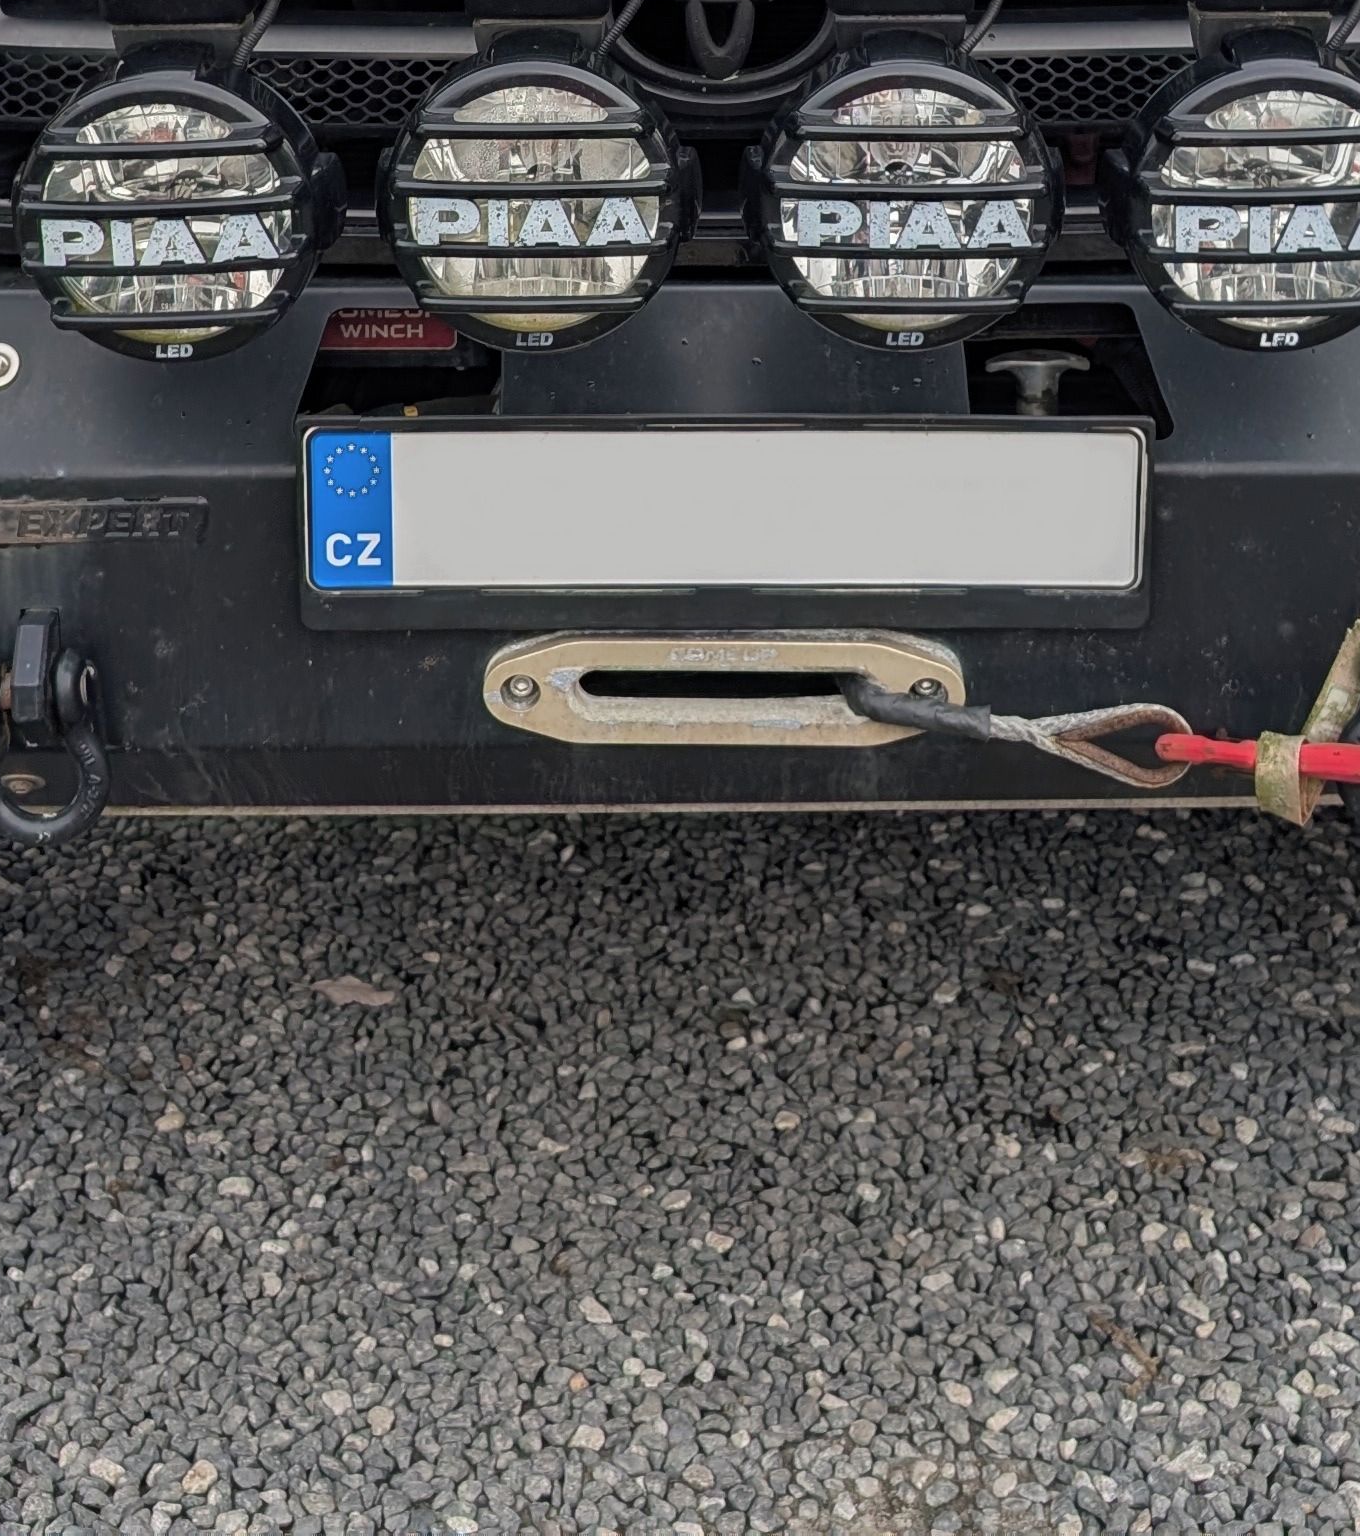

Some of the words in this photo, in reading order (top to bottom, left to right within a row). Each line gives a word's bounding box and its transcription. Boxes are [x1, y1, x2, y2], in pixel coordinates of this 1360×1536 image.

[414, 196, 653, 248] PIAA
[795, 199, 1032, 250] PIAA
[39, 212, 281, 268] PIAA
[339, 323, 424, 339] WINCH
[514, 331, 554, 347] LED
[885, 331, 925, 346] LED
[155, 343, 193, 360] LED
[324, 532, 383, 568] CZ
